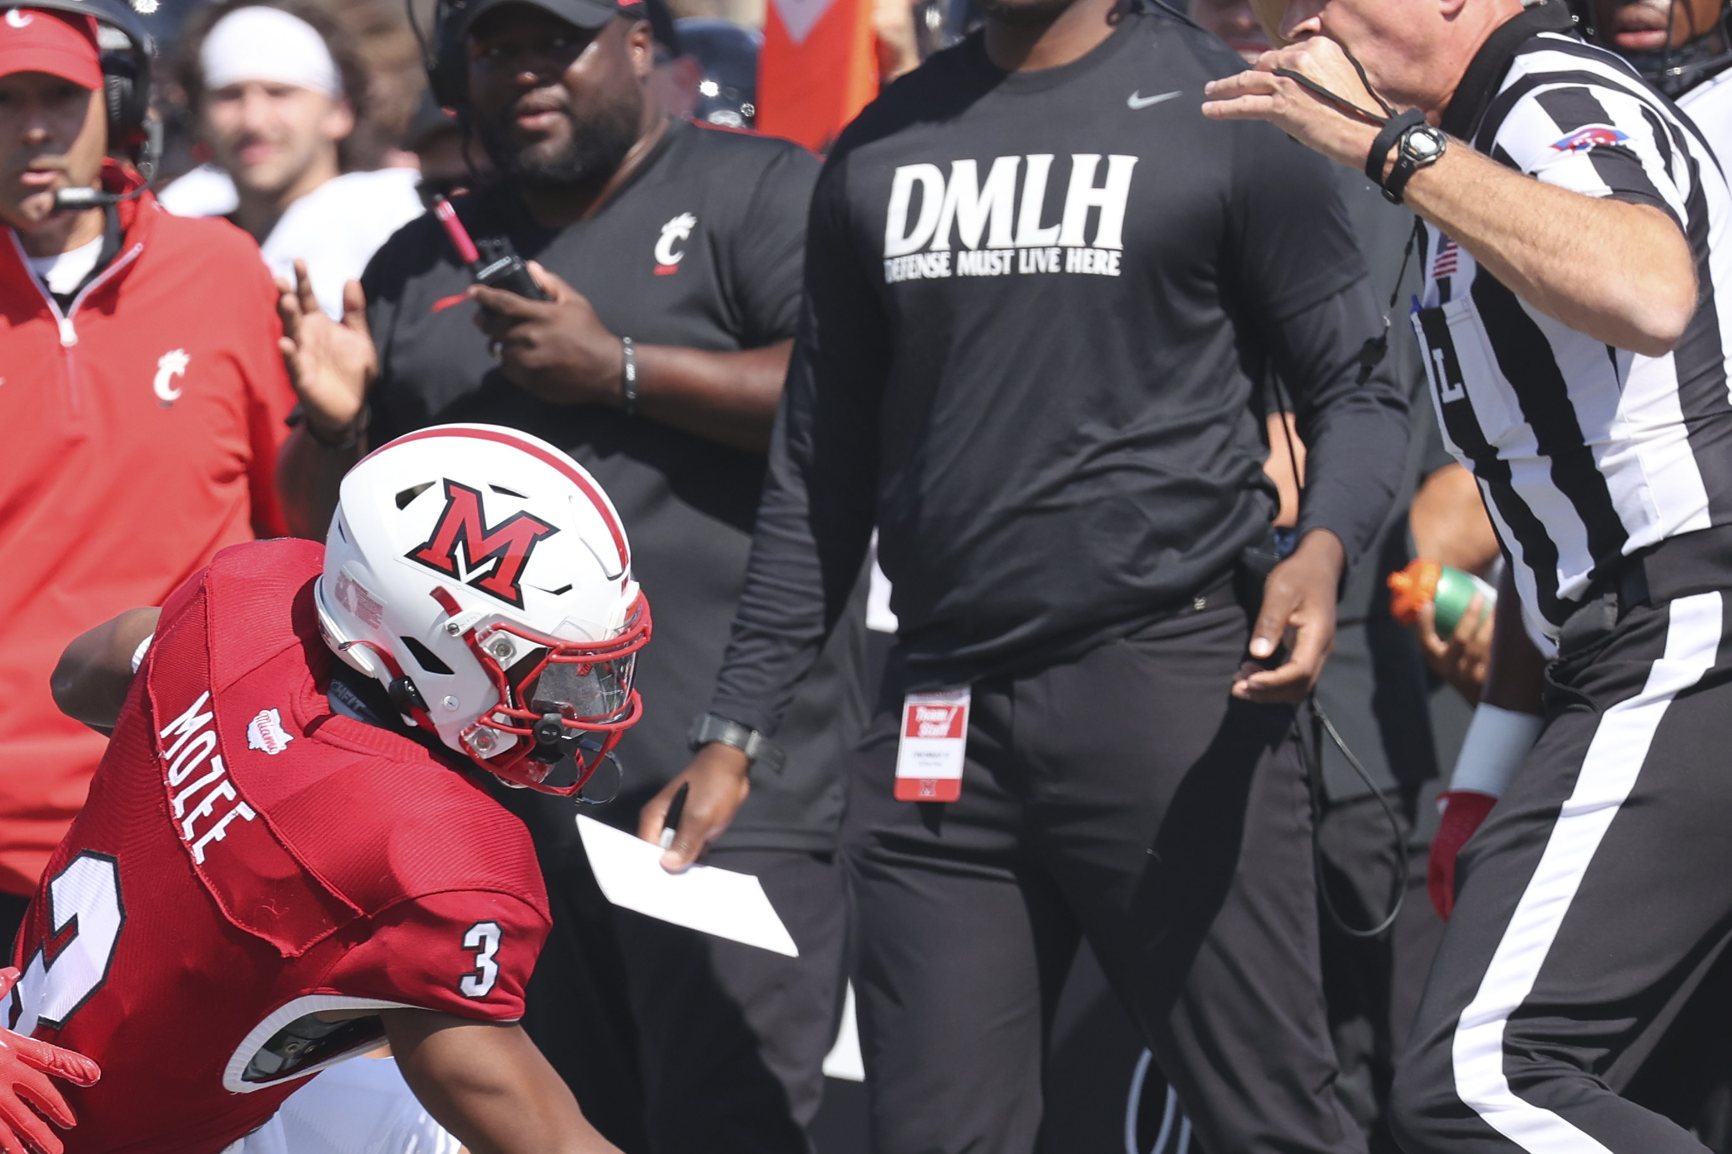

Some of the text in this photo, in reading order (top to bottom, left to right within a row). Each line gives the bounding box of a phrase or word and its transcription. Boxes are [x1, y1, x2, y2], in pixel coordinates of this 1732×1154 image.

[884, 153, 1139, 258] DMLH
[883, 246, 1123, 285] DEFENSE MUST LIVE HERE
[1432, 348, 1466, 404] L
[403, 477, 562, 612] M
[160, 690, 256, 865] MOZEE
[458, 920, 504, 999] 3
